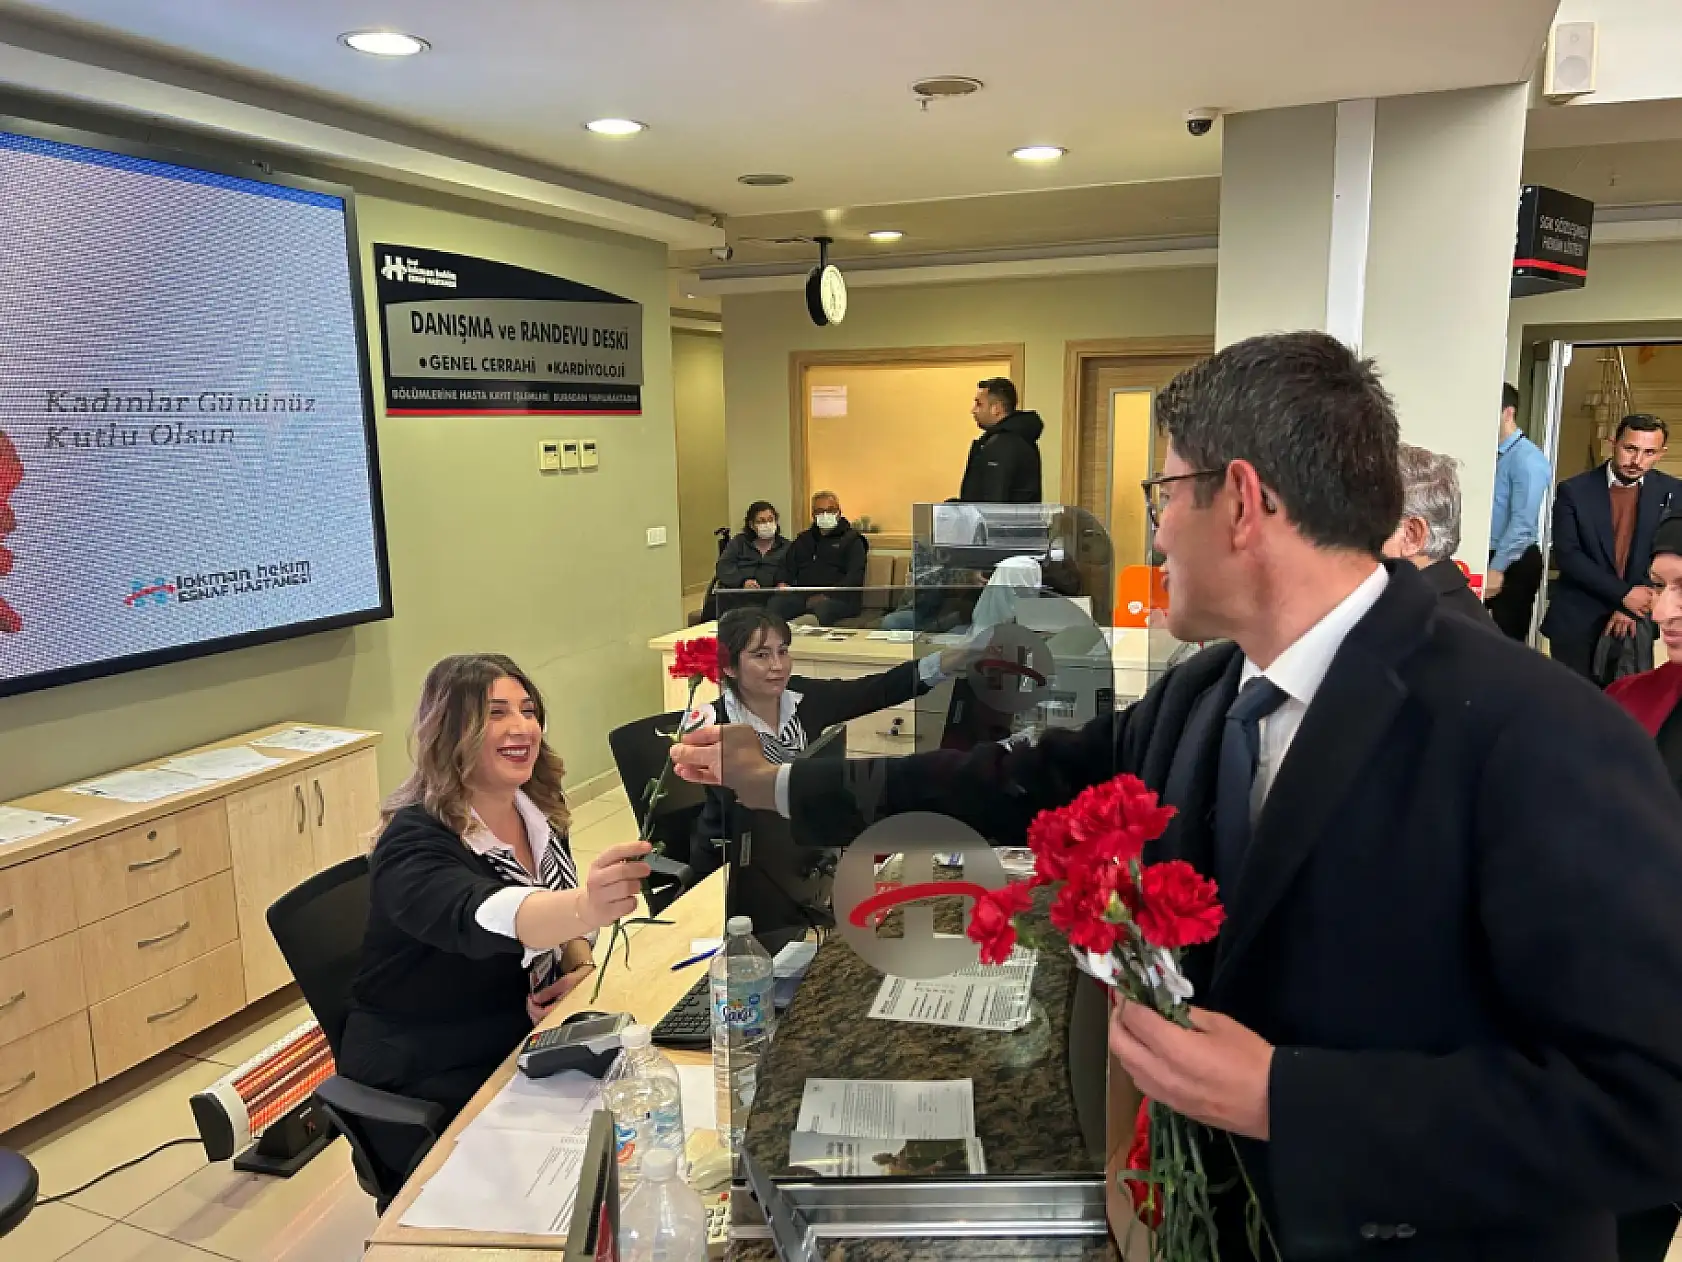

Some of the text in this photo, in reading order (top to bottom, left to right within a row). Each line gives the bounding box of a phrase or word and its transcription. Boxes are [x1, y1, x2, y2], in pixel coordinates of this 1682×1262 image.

[410, 310, 628, 350] DANIŞMA ve RANDEVU DESKİ
[430, 354, 626, 378] GENEL CERRAHİ KARDİYOLOJİ
[46, 388, 317, 413] Kadınlar Gününüz
[459, 389, 488, 400] HASTA
[47, 422, 235, 447] Kutlu Olsun
[176, 570, 250, 589] lokman
